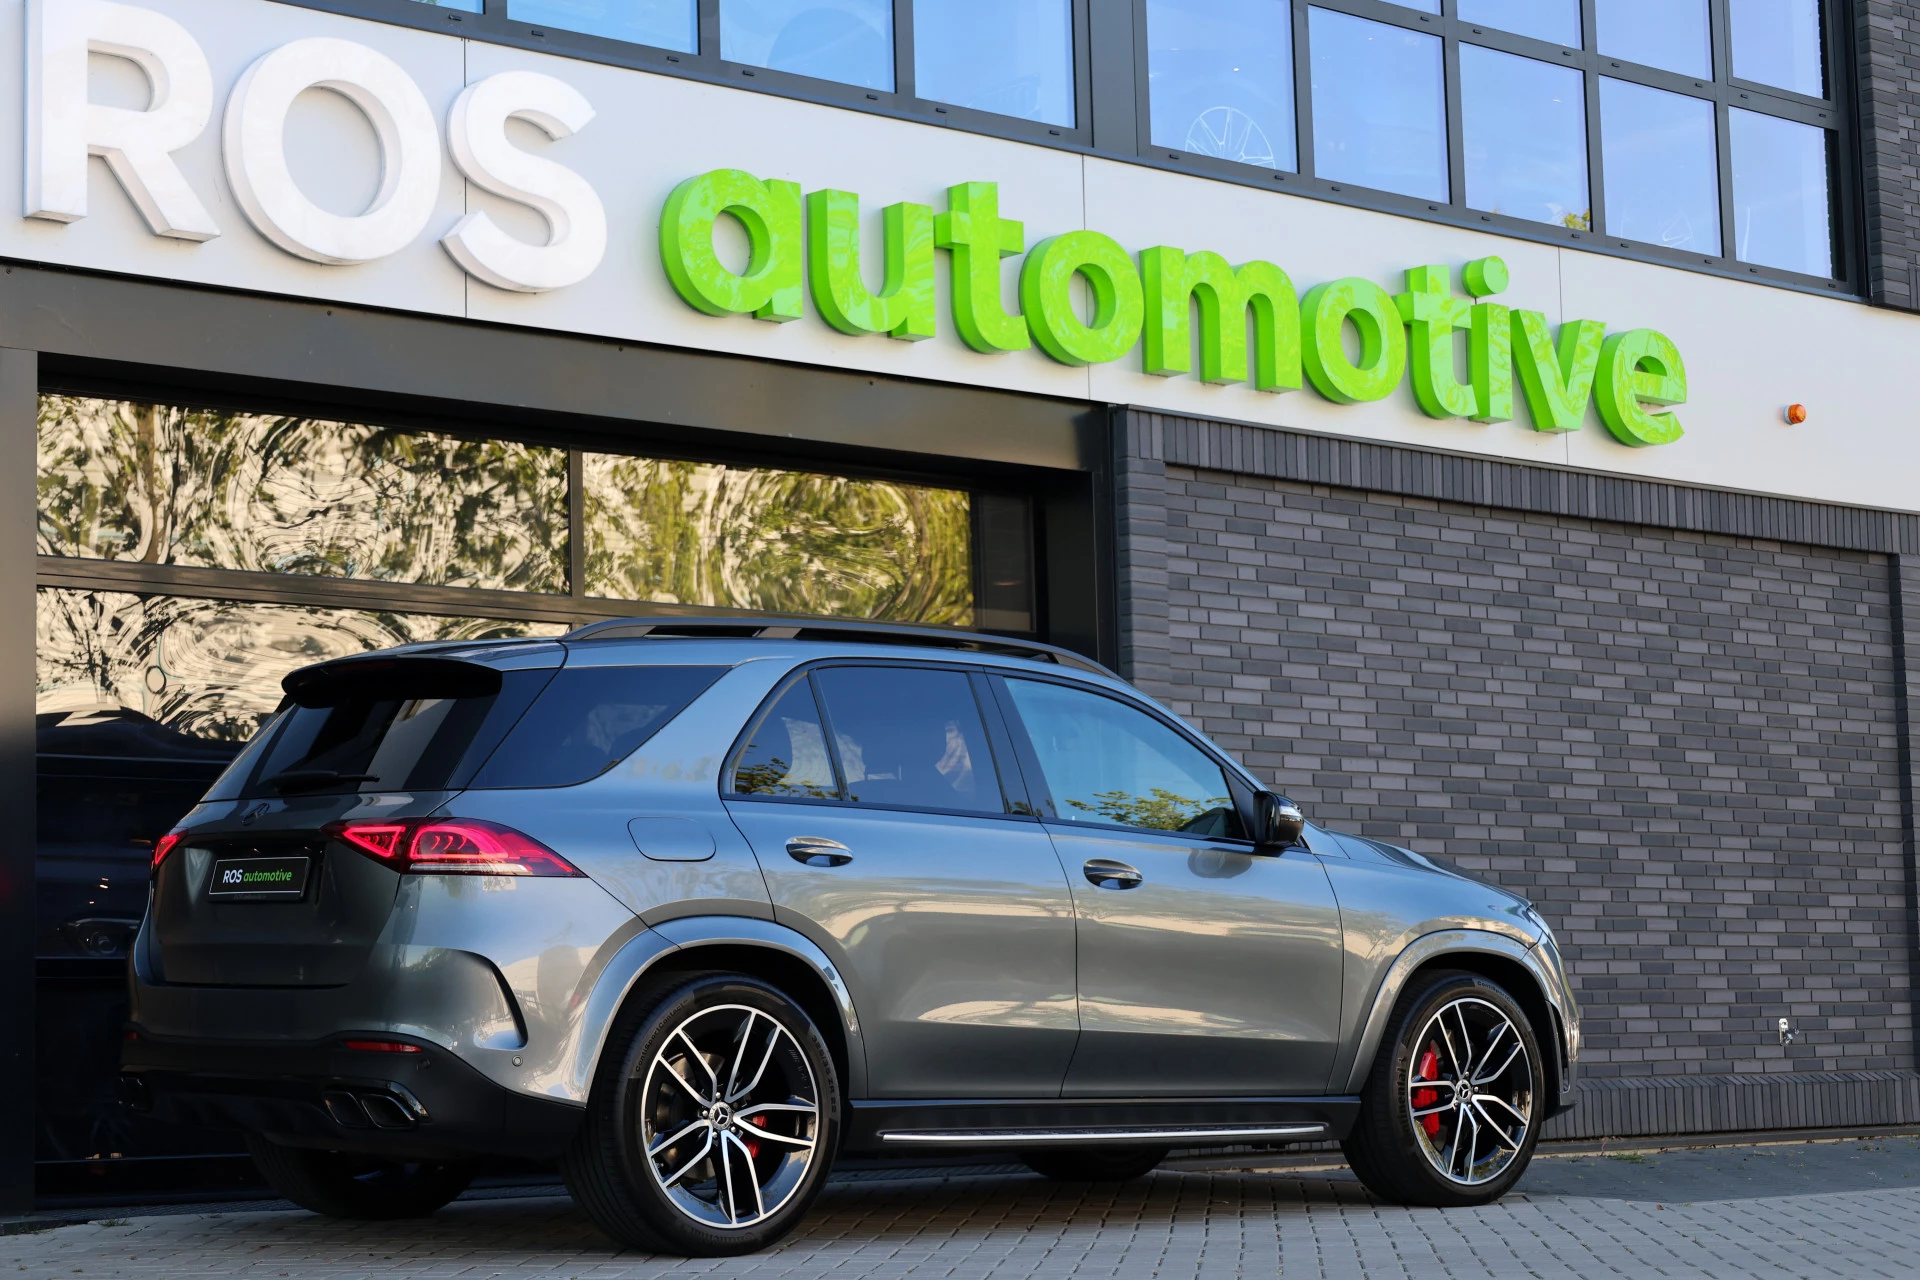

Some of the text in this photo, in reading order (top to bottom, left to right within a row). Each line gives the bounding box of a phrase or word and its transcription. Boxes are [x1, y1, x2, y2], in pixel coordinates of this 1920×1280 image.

[23, 0, 1688, 447] ROS automotive
[222, 868, 293, 884] ROS automotive
